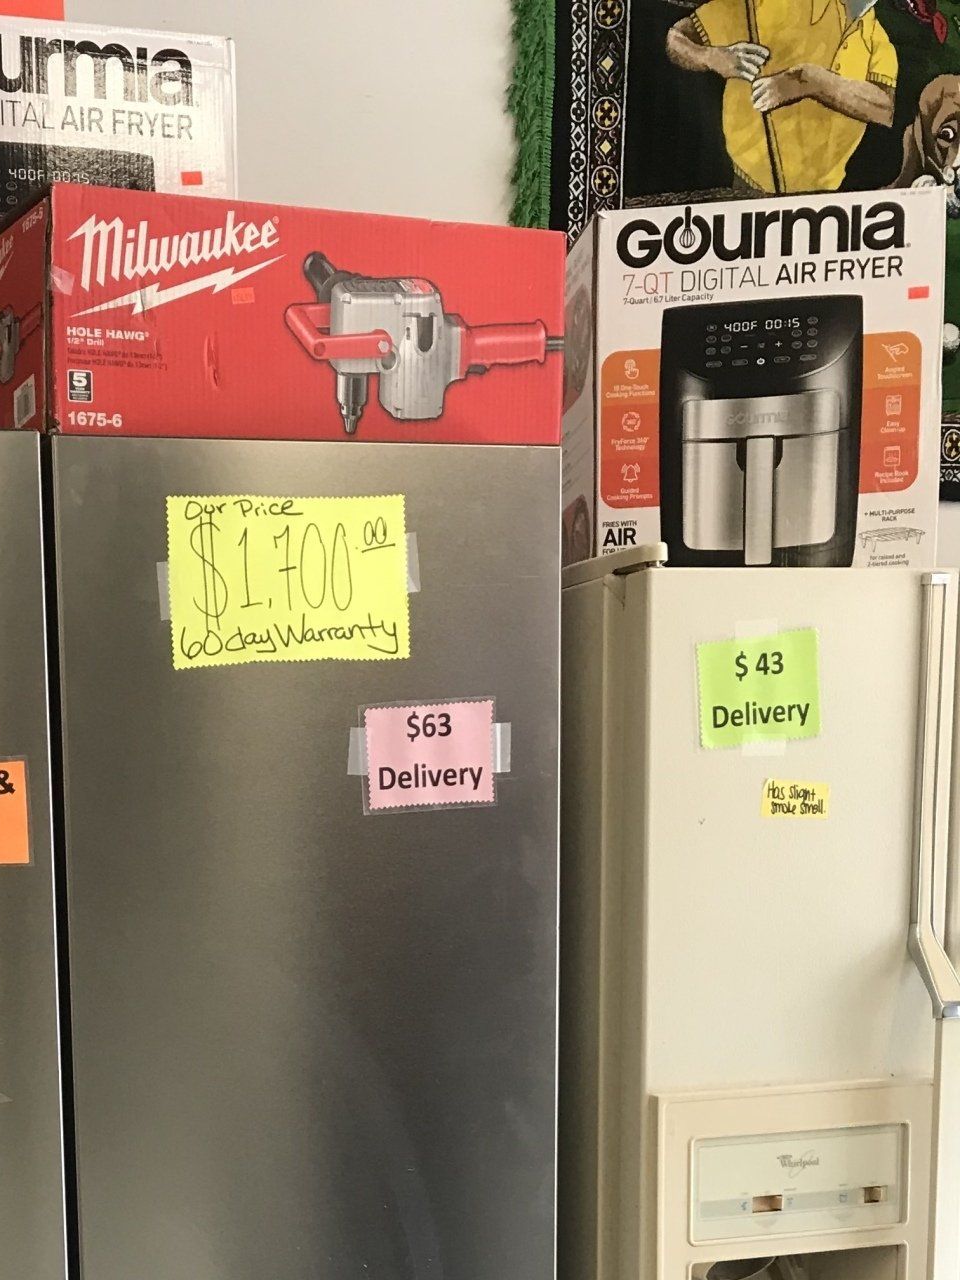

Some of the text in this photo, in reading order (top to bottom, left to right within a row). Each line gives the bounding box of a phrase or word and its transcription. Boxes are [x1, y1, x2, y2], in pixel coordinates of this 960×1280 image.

[61, 105, 104, 134] AIR
[112, 108, 193, 141] FRYER
[8, 168, 45, 180] 400F
[616, 202, 905, 268] Gourmia
[66, 210, 280, 292] Milwaukee
[623, 256, 903, 296] 7-QT DIGITAL AIR FRYER
[682, 293, 714, 301] Capacity
[66, 326, 102, 337] HOLE
[724, 317, 800, 332] 400F 00:15
[72, 372, 87, 386] 5
[68, 411, 122, 427] 1675-6
[185, 498, 304, 521] Our Price
[603, 528, 636, 546] AIR
[180, 612, 398, 660] 60 day Warranty
[755, 651, 784, 676] 43
[712, 701, 810, 729] Delivery
[406, 712, 452, 742] $63
[378, 764, 483, 790] Delivery
[767, 780, 785, 800] Has
[777, 1154, 820, 1169] Whirlpool
